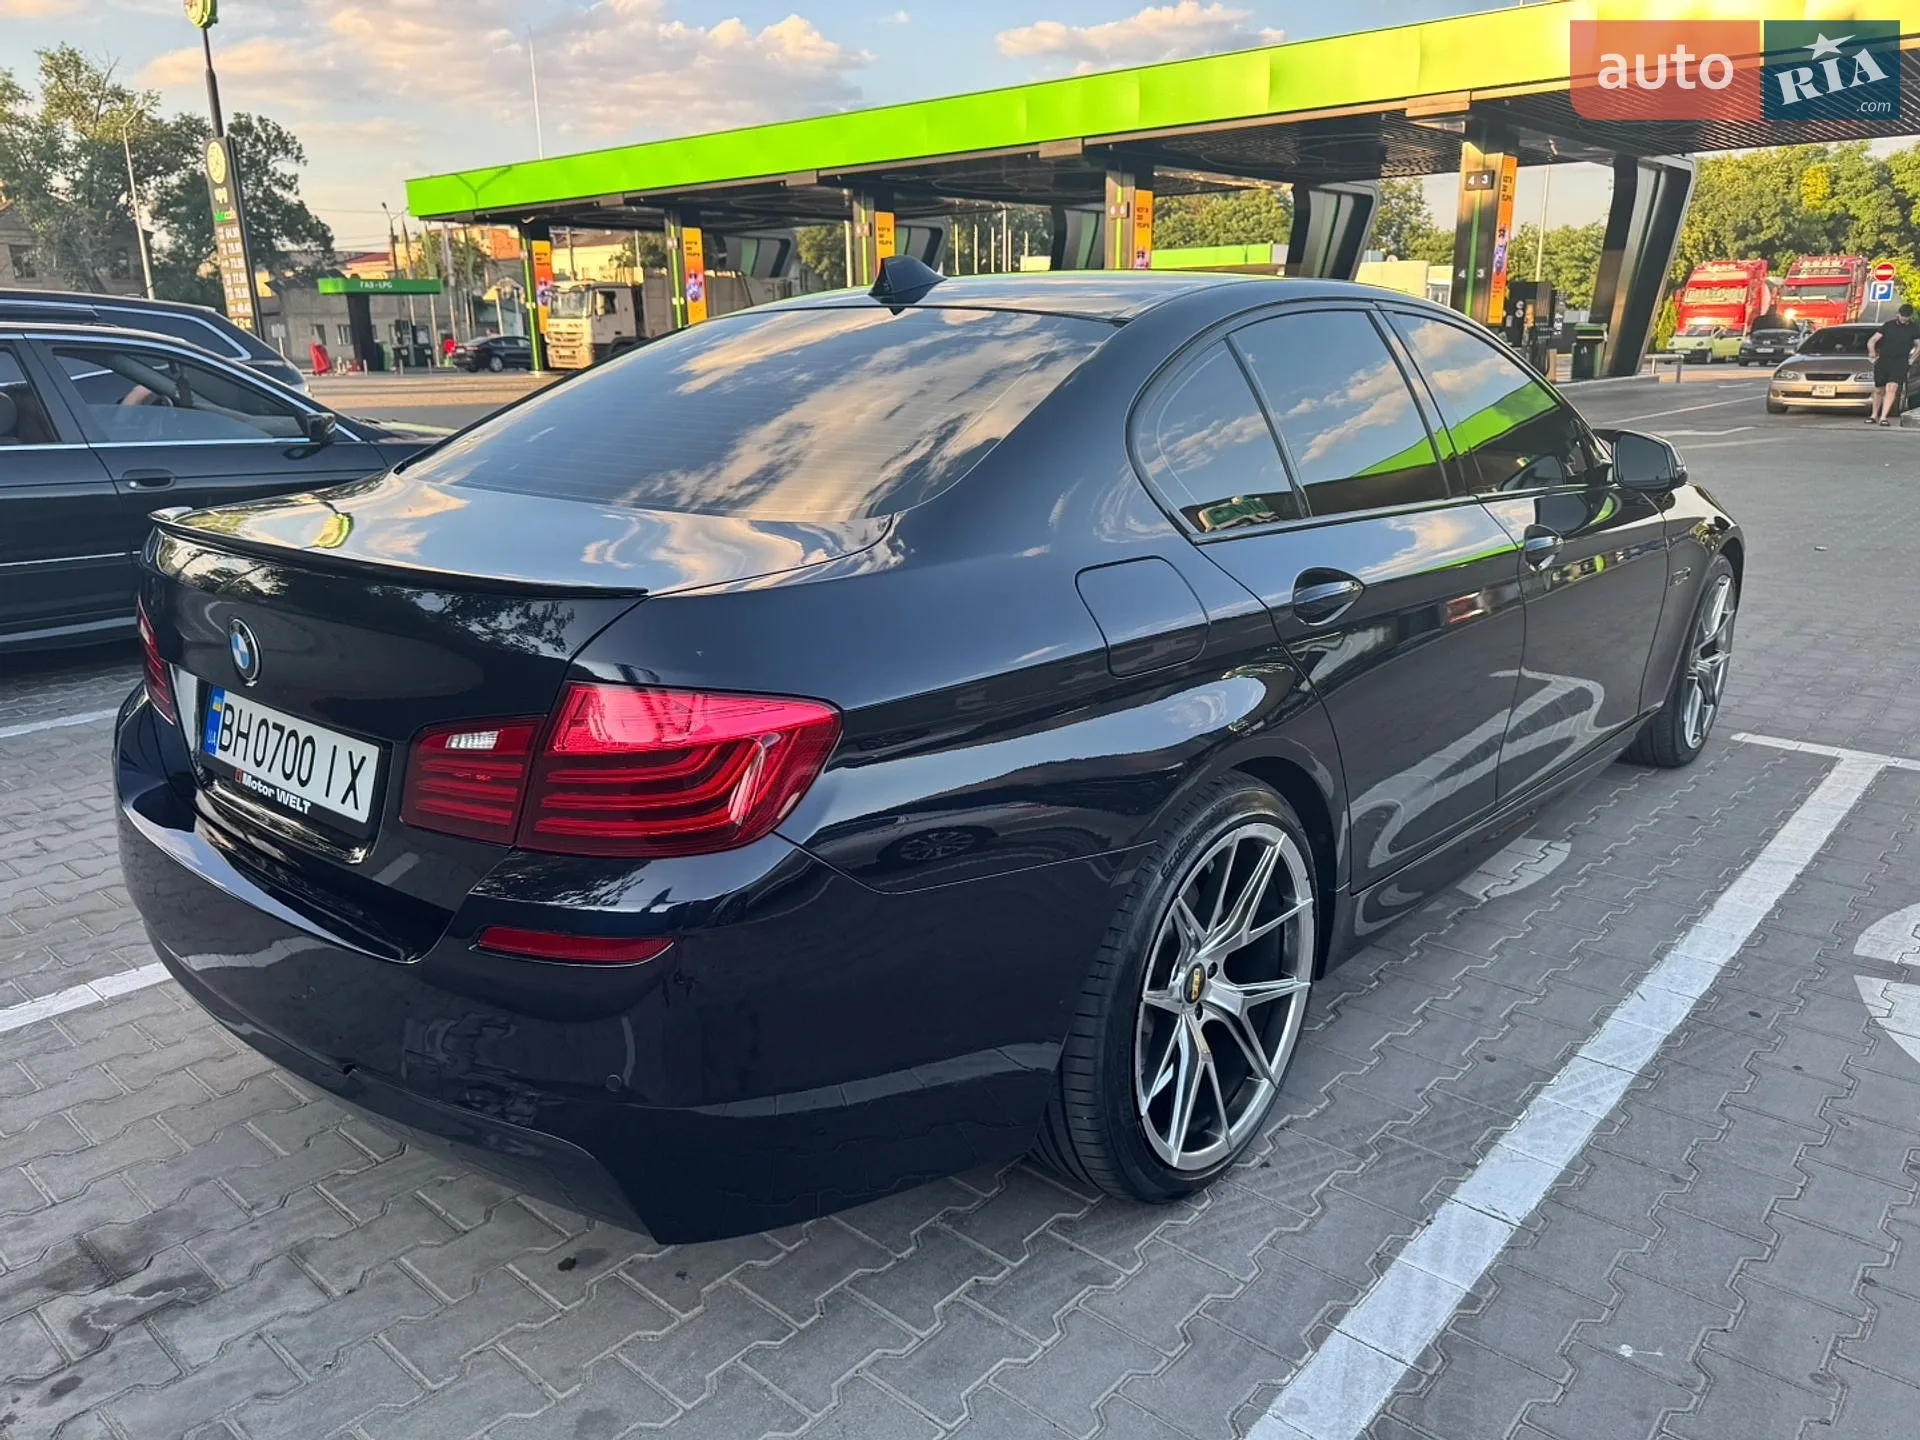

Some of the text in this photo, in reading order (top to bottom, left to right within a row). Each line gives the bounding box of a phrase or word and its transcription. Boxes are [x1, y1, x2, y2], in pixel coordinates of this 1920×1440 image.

[1468, 174, 1489, 185] 4 3
[1458, 268, 1485, 278] 4 3
[1875, 284, 1888, 299] P
[276, 788, 311, 815] WELT
